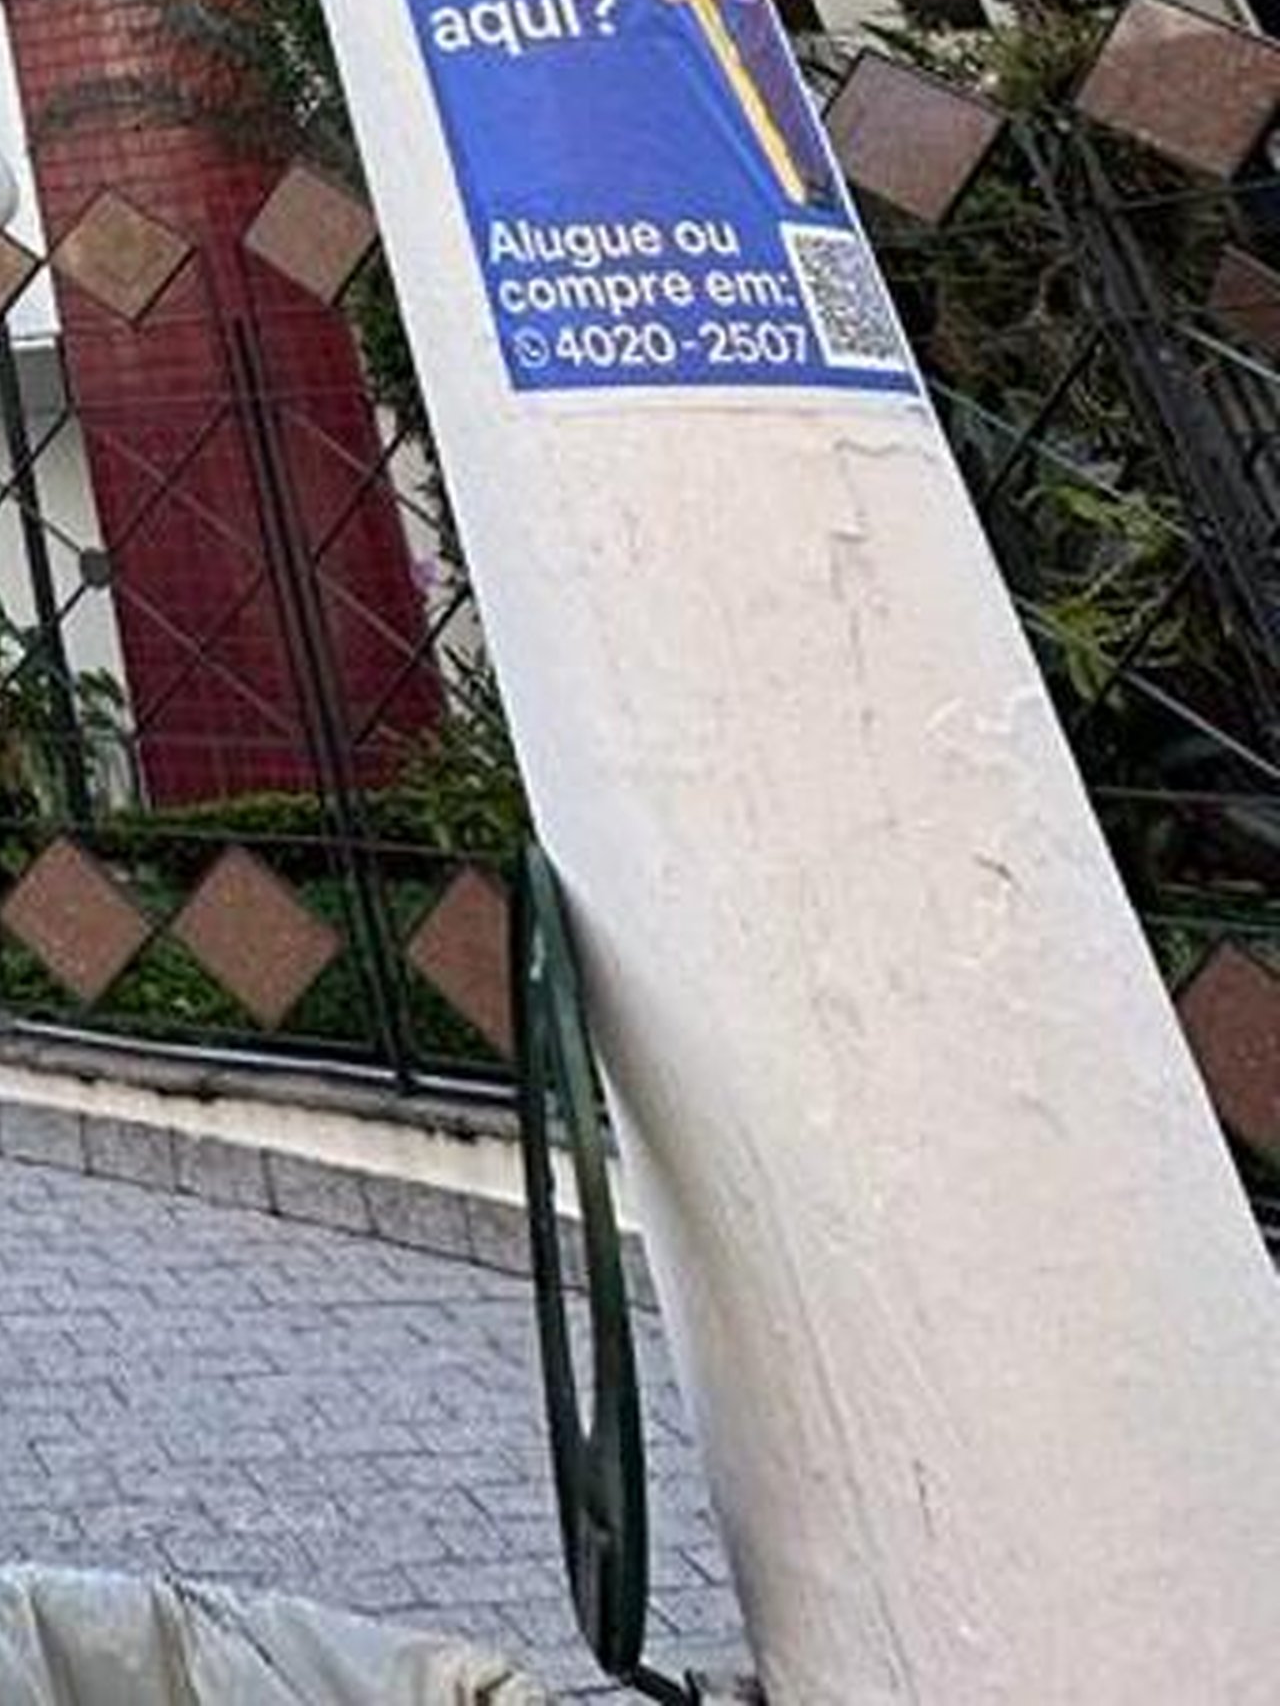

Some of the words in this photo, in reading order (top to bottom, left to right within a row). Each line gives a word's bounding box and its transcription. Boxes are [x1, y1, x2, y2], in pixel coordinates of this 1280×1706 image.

[488, 218, 661, 267] Alugue
[673, 219, 740, 256] ou
[498, 269, 693, 315] compre
[707, 269, 798, 308] em:
